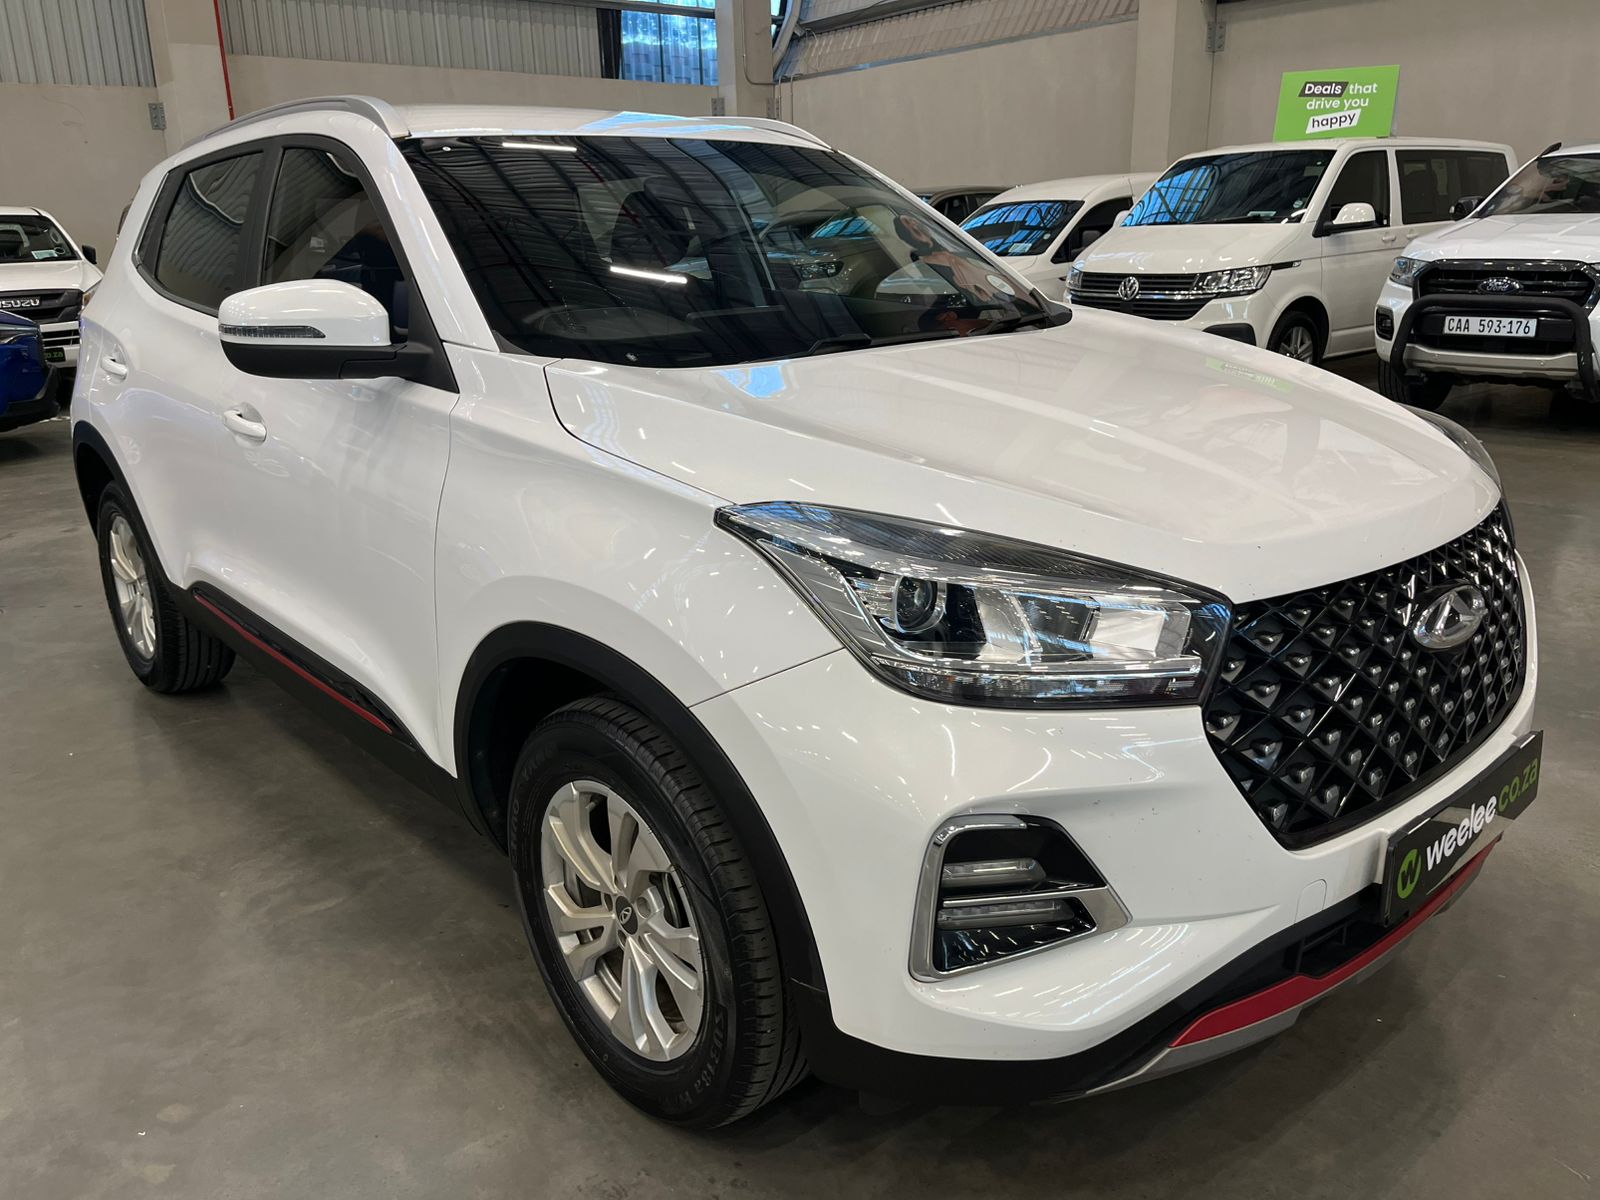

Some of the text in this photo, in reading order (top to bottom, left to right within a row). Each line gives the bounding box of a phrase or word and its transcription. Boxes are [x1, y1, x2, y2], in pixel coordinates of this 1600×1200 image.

[1304, 82, 1378, 95] Deals that
[1306, 97, 1369, 110] drive you
[1311, 112, 1356, 128] happy
[1486, 281, 1510, 292] Ford
[0, 298, 40, 308] ISUZU
[1447, 318, 1531, 335] CAA 593-176
[1426, 795, 1498, 872] weelee
